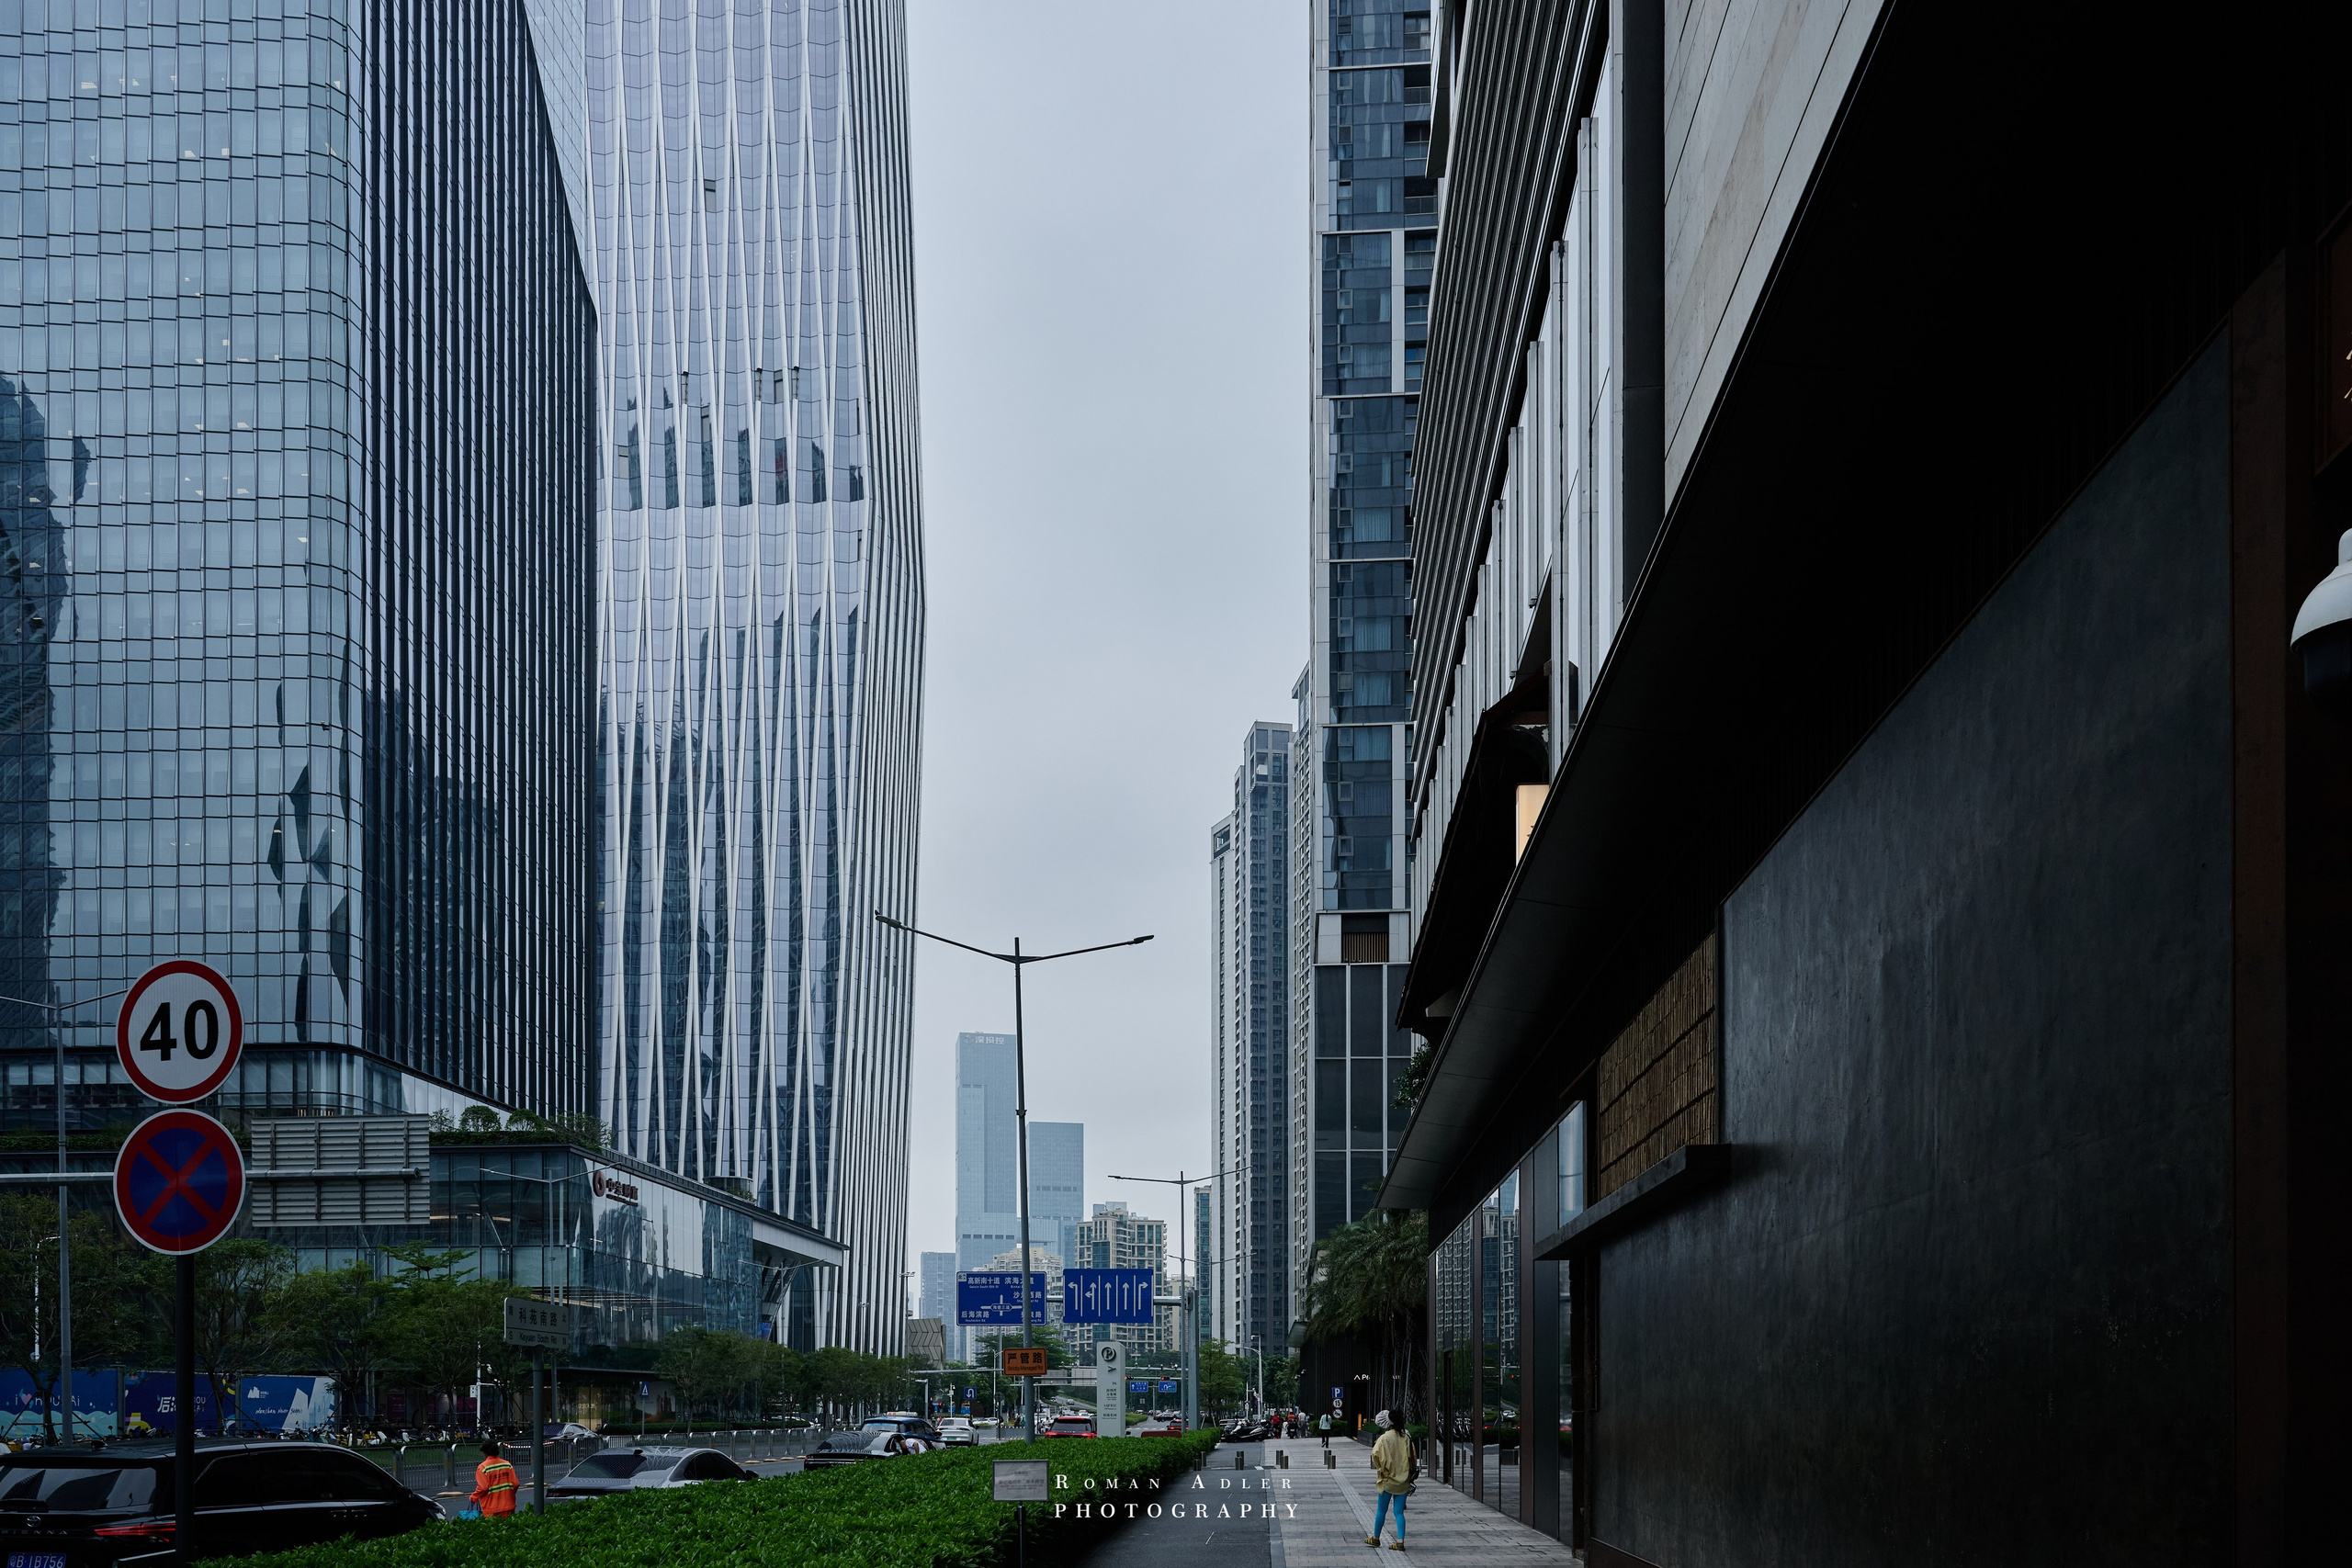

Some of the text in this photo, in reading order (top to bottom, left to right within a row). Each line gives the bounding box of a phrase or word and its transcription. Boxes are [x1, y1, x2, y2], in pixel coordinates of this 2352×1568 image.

[140, 998, 219, 1061] 40
[975, 1035, 1005, 1045] 深投控
[1012, 1291, 1042, 1299] 沙西路
[519, 1307, 557, 1326] 科苑南路
[561, 1313, 567, 1323] 北
[508, 1331, 567, 1345] S Keyuan South Rd N
[1007, 1352, 1043, 1364] 严管路
[1334, 1387, 1340, 1398] P
